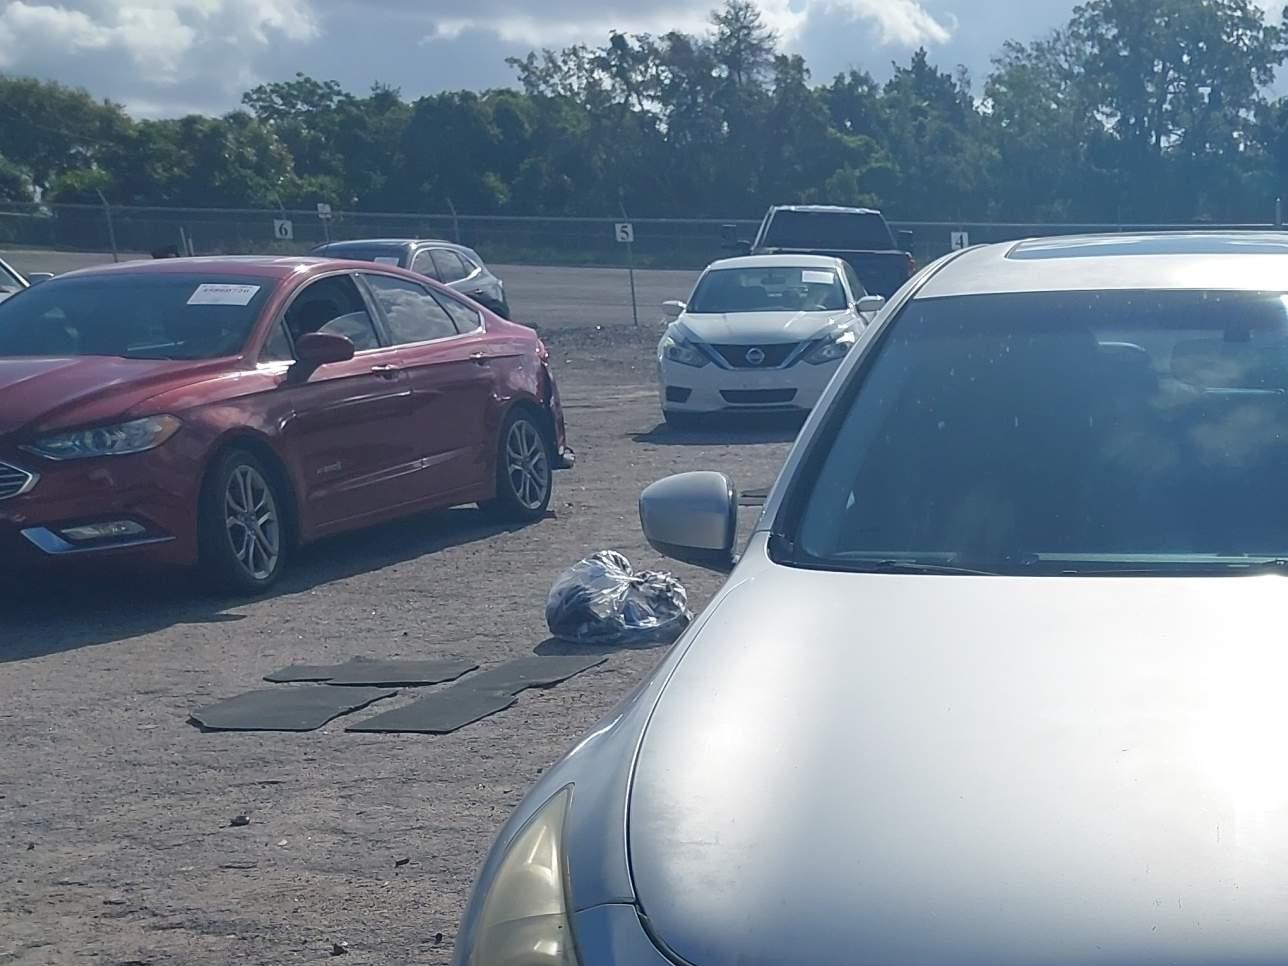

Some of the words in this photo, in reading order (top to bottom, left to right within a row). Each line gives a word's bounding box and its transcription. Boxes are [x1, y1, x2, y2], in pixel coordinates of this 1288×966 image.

[279, 223, 288, 237] 6
[620, 225, 629, 241] 5
[954, 233, 963, 249] 4
